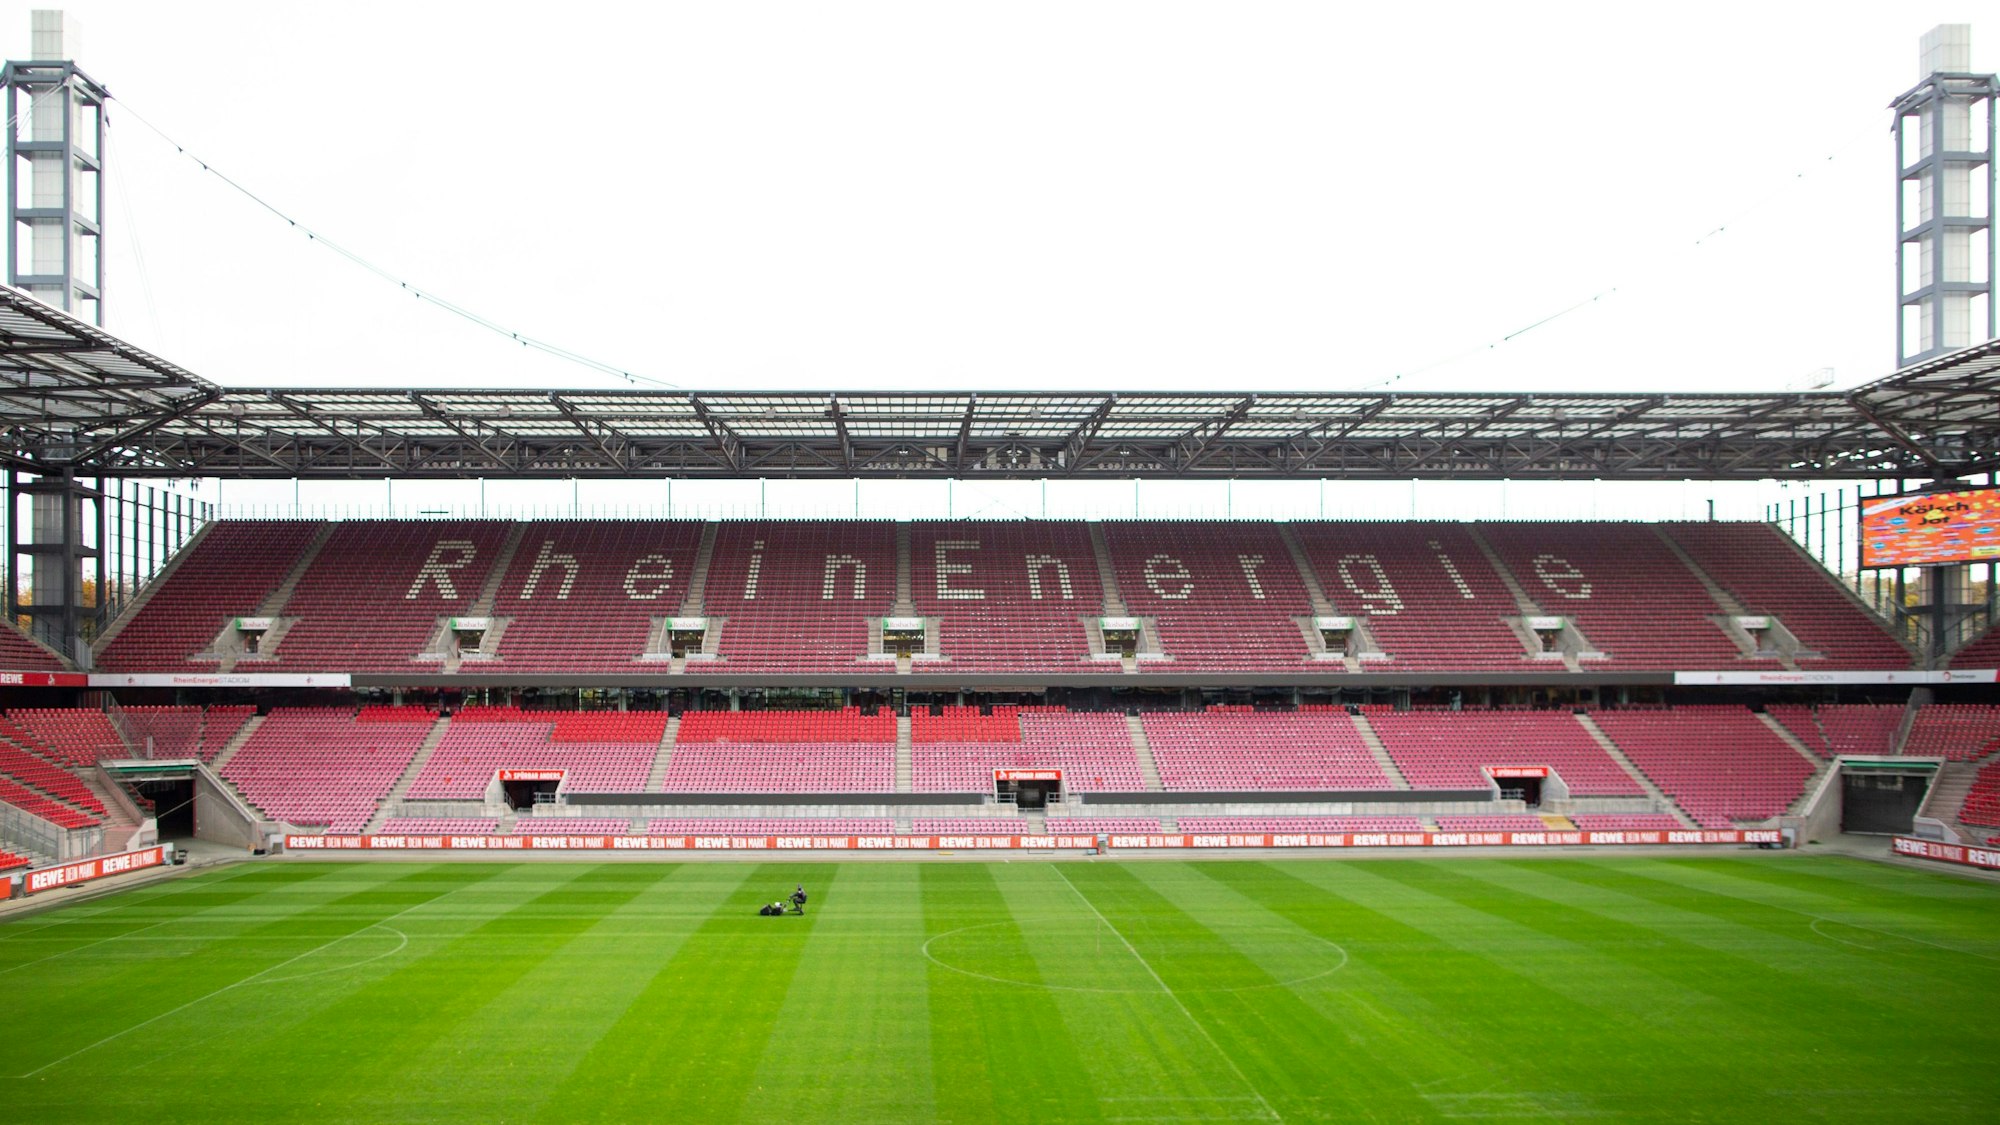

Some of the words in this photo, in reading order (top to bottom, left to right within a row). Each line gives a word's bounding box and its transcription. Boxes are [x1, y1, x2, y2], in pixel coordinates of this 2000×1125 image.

[1900, 502, 1969, 515] Kölsch
[1, 673, 23, 684] REWE
[1020, 837, 1055, 848] REWE
[1058, 836, 1072, 847] DEIN
[1073, 836, 1093, 847] MARKT
[1112, 836, 1147, 847] REWE
[1149, 836, 1164, 847] DEIN
[1165, 836, 1185, 847] MARKT
[1193, 835, 1228, 846] REWE
[1230, 835, 1244, 846] DEIN
[1245, 835, 1265, 846] MARKT
[1273, 835, 1307, 846] REWE
[1310, 835, 1324, 846] DEIN
[1325, 835, 1345, 846] MARKT
[1353, 834, 1388, 845] REWE
[1390, 834, 1404, 845] DEIN
[1405, 834, 1424, 845] MARKT
[1432, 834, 1467, 845] REWE
[1468, 833, 1483, 844] DEIN
[1512, 833, 1545, 844] REWE
[1590, 832, 1623, 843] REWE
[1669, 831, 1701, 842] REWE
[1745, 831, 1777, 842] REWE
[290, 837, 324, 848] REWE
[371, 837, 405, 848] REWE
[408, 837, 422, 848] DEIN
[423, 837, 443, 848] MARKT
[452, 837, 486, 848] REWE
[489, 837, 502, 848] DEIN
[504, 837, 523, 848] MARKT
[533, 837, 567, 848] REWE
[570, 837, 583, 848] DEIN
[585, 837, 605, 848] MARKT
[614, 837, 648, 848] REWE
[651, 837, 665, 848] DEIN
[666, 837, 686, 848] MARKT
[695, 837, 729, 848] REWE
[732, 837, 746, 848] DEIN
[748, 837, 768, 848] MARKT
[777, 837, 811, 848] REWE
[814, 837, 828, 848] DEIN
[829, 837, 849, 848] MARKT
[858, 837, 893, 848] REWE
[895, 837, 909, 848] DEIN
[910, 837, 930, 848] MARKT
[939, 837, 974, 848] REWE
[976, 837, 990, 848] DEIN
[992, 837, 1011, 848] MARKT
[1895, 838, 1928, 855] REWE
[103, 855, 130, 874] REWE
[32, 868, 64, 890] REWE
